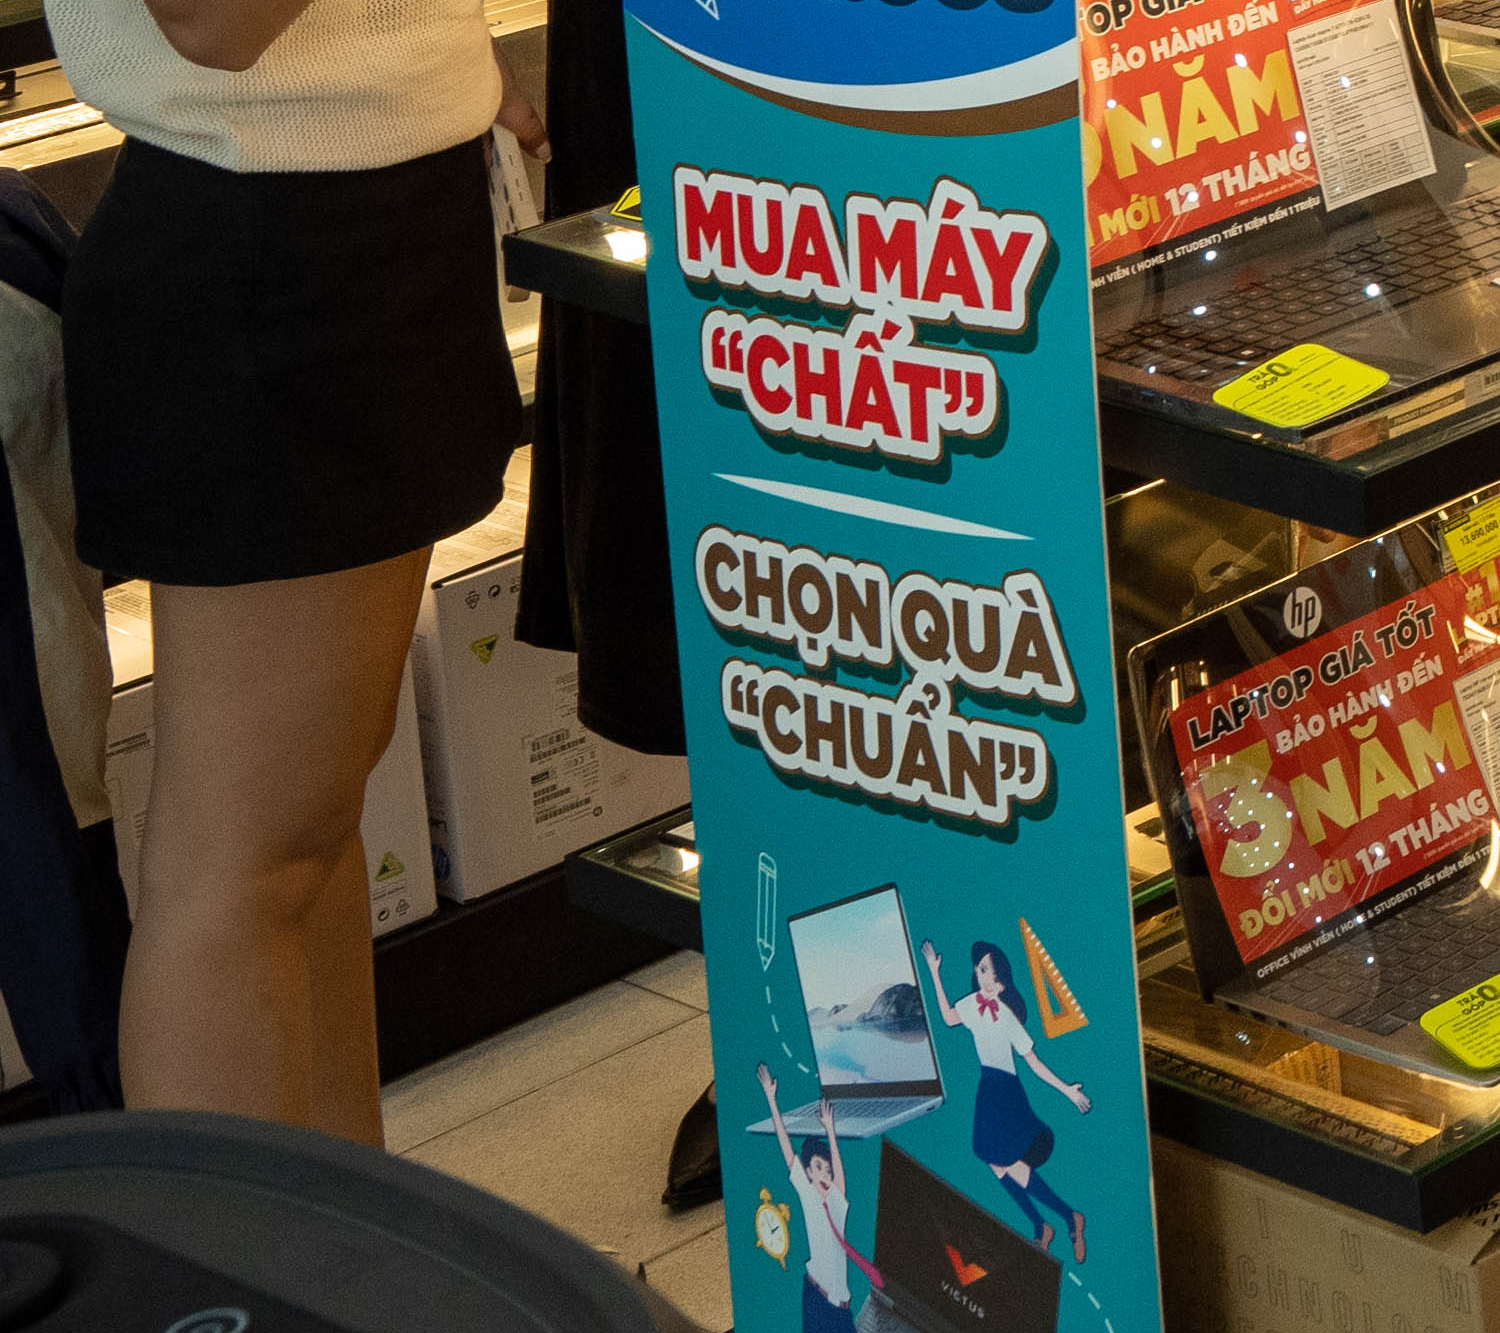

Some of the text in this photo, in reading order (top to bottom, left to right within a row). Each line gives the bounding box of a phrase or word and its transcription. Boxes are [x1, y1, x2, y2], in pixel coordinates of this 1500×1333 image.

[681, 182, 1035, 322] MUA MÁY
[702, 536, 1064, 690] CHỌN QUÀ
[1187, 599, 1436, 751] LAPTOP GIÁ TỐT
[1285, 587, 1321, 638] hp
[1275, 655, 1445, 755] BẢO HÀNH ĐẾN
[1200, 700, 1473, 878] 3 NĂM
[1238, 786, 1490, 941] ĐỔI MỚI 12 THÁNG
[940, 1280, 985, 1319] VICTUS
